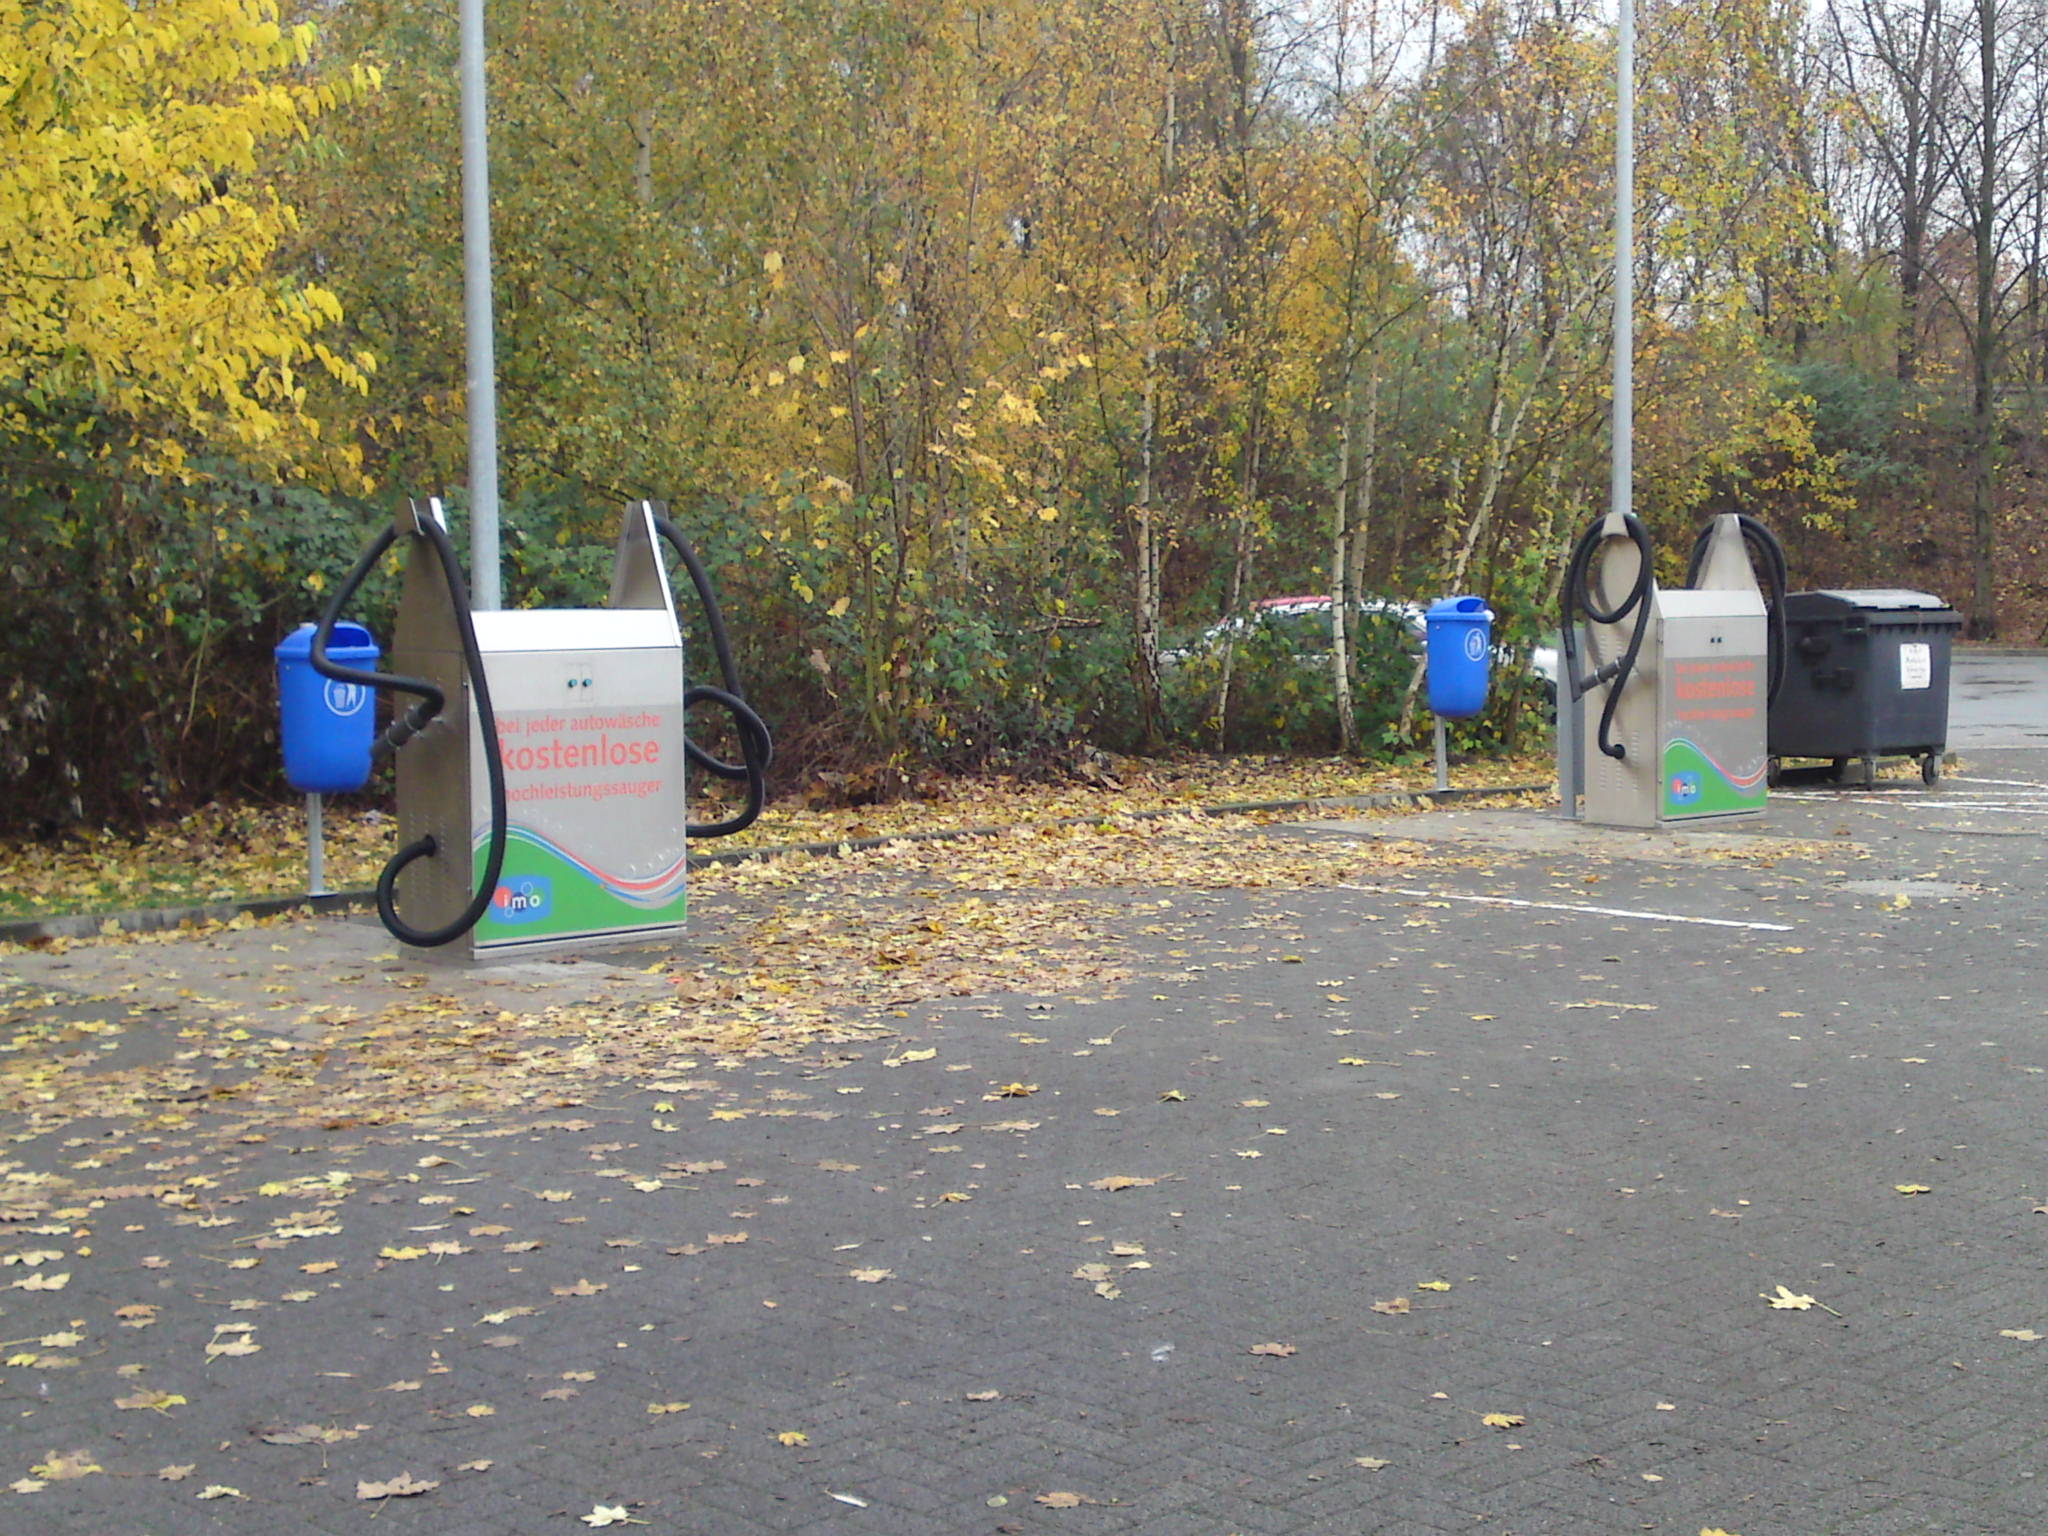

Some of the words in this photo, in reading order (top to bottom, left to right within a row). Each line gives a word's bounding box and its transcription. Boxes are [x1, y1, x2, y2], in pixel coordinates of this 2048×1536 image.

[496, 717, 520, 734] bei
[526, 715, 566, 737] jeder
[571, 711, 662, 731] autowäsche
[498, 734, 660, 771] kostenlose
[503, 894, 541, 909] imo
